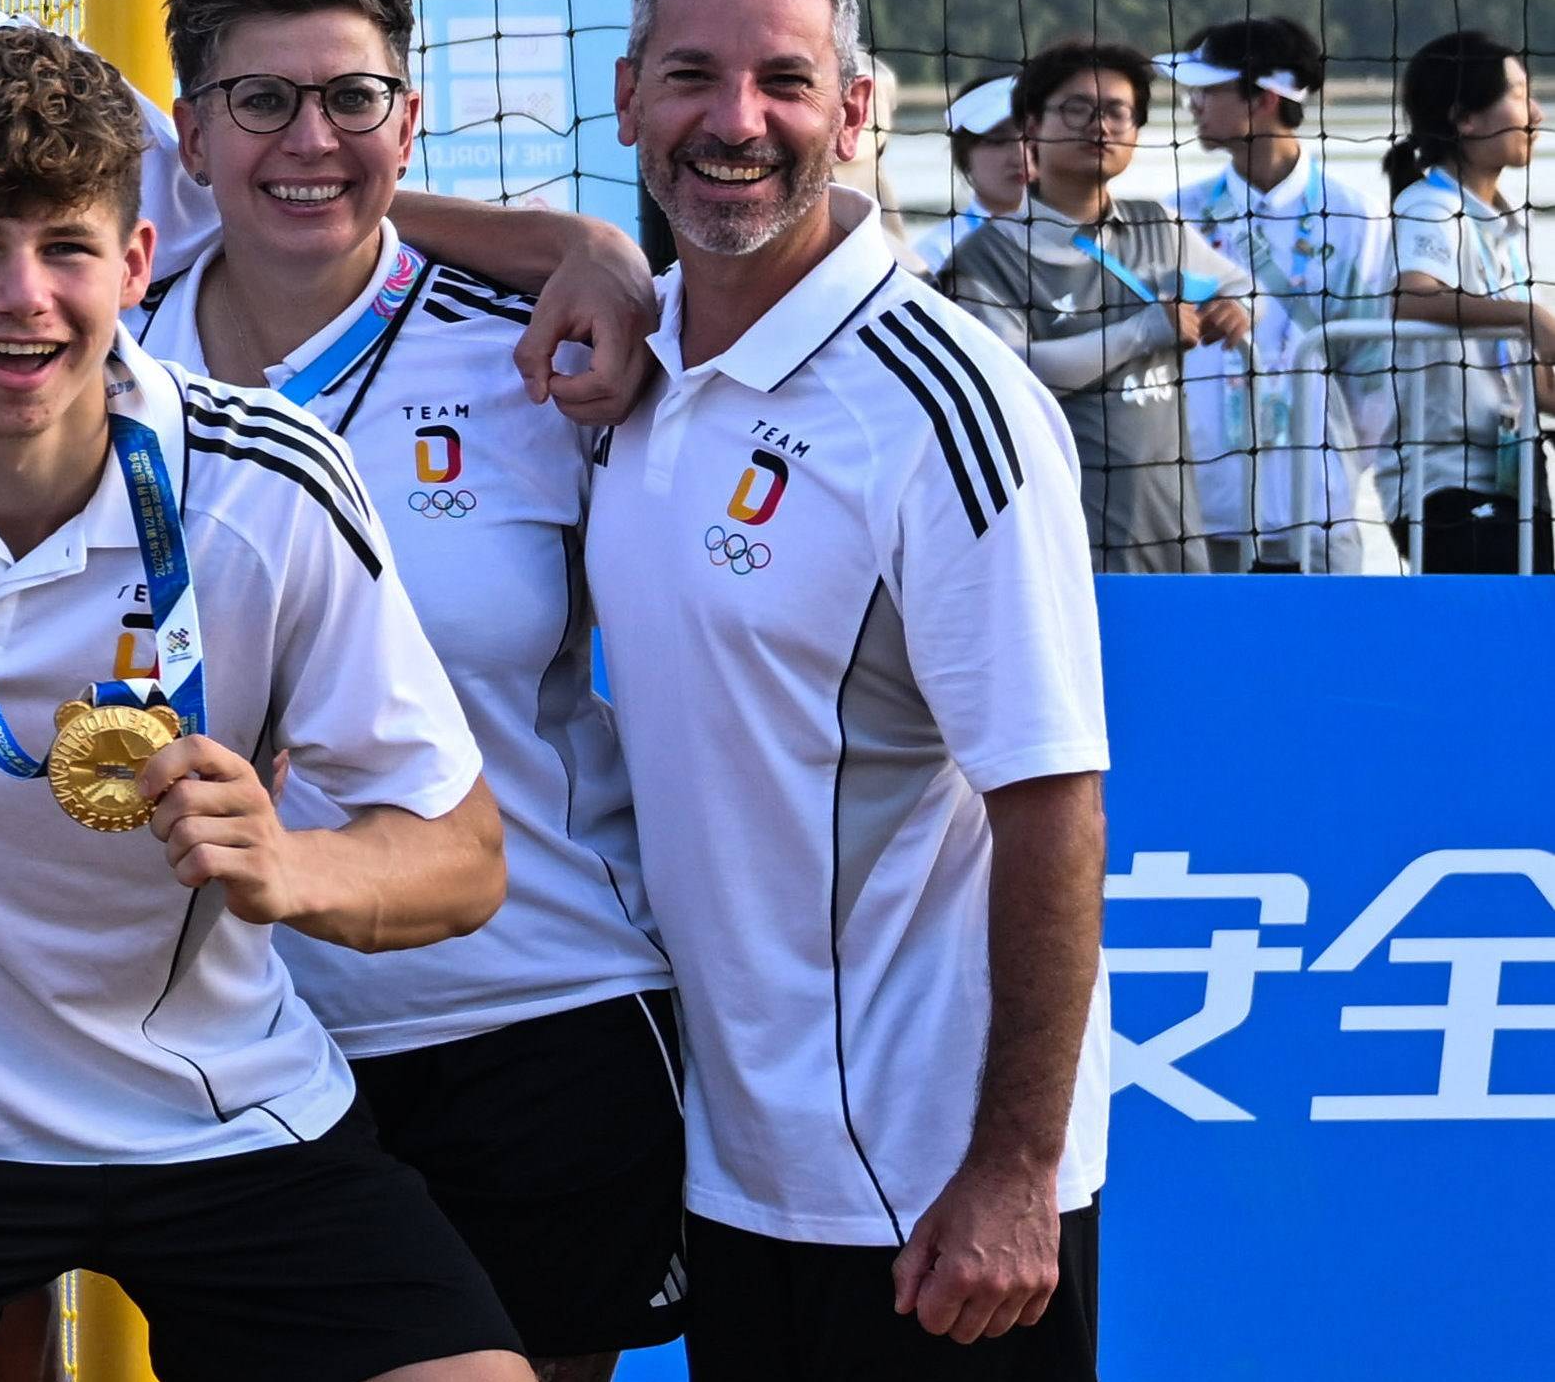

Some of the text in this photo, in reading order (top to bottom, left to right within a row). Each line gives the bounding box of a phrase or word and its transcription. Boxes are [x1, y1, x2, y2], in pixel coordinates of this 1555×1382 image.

[403, 405, 469, 419] TEAM
[753, 419, 810, 458] TEAM
[117, 583, 147, 603] TE
[1105, 848, 1555, 1122] 安全
